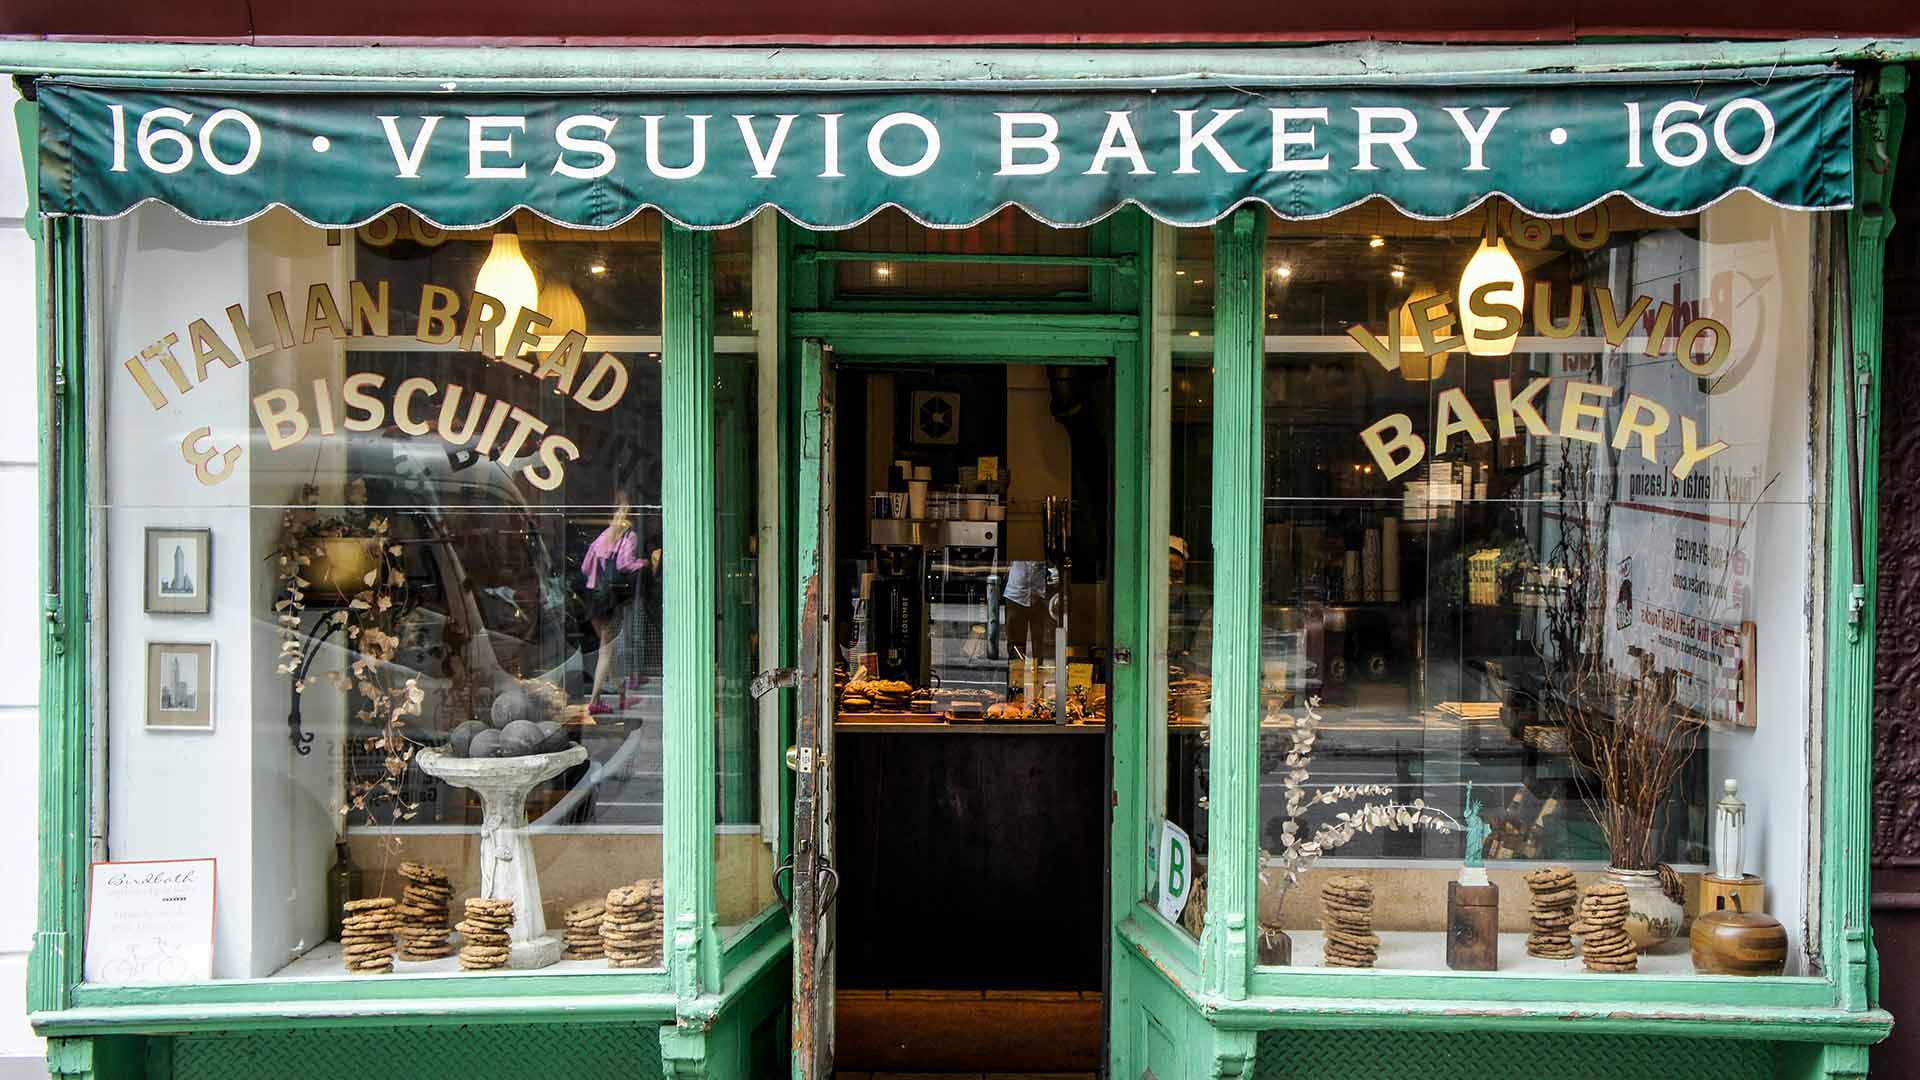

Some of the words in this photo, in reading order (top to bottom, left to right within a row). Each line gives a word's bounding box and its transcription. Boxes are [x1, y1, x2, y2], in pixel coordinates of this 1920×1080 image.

[106, 104, 262, 176] 160
[376, 112, 941, 180] VESUVIO
[992, 105, 1510, 178] BAKERY
[1623, 97, 1776, 169] 160
[124, 280, 392, 411] ITALIAN
[415, 283, 630, 412] BREAD
[1346, 280, 1732, 376] VESUVIO
[181, 425, 243, 487] &
[253, 371, 582, 492] BISCUITS
[1359, 376, 1730, 482] BAKERY
[1169, 837, 1185, 897] B
